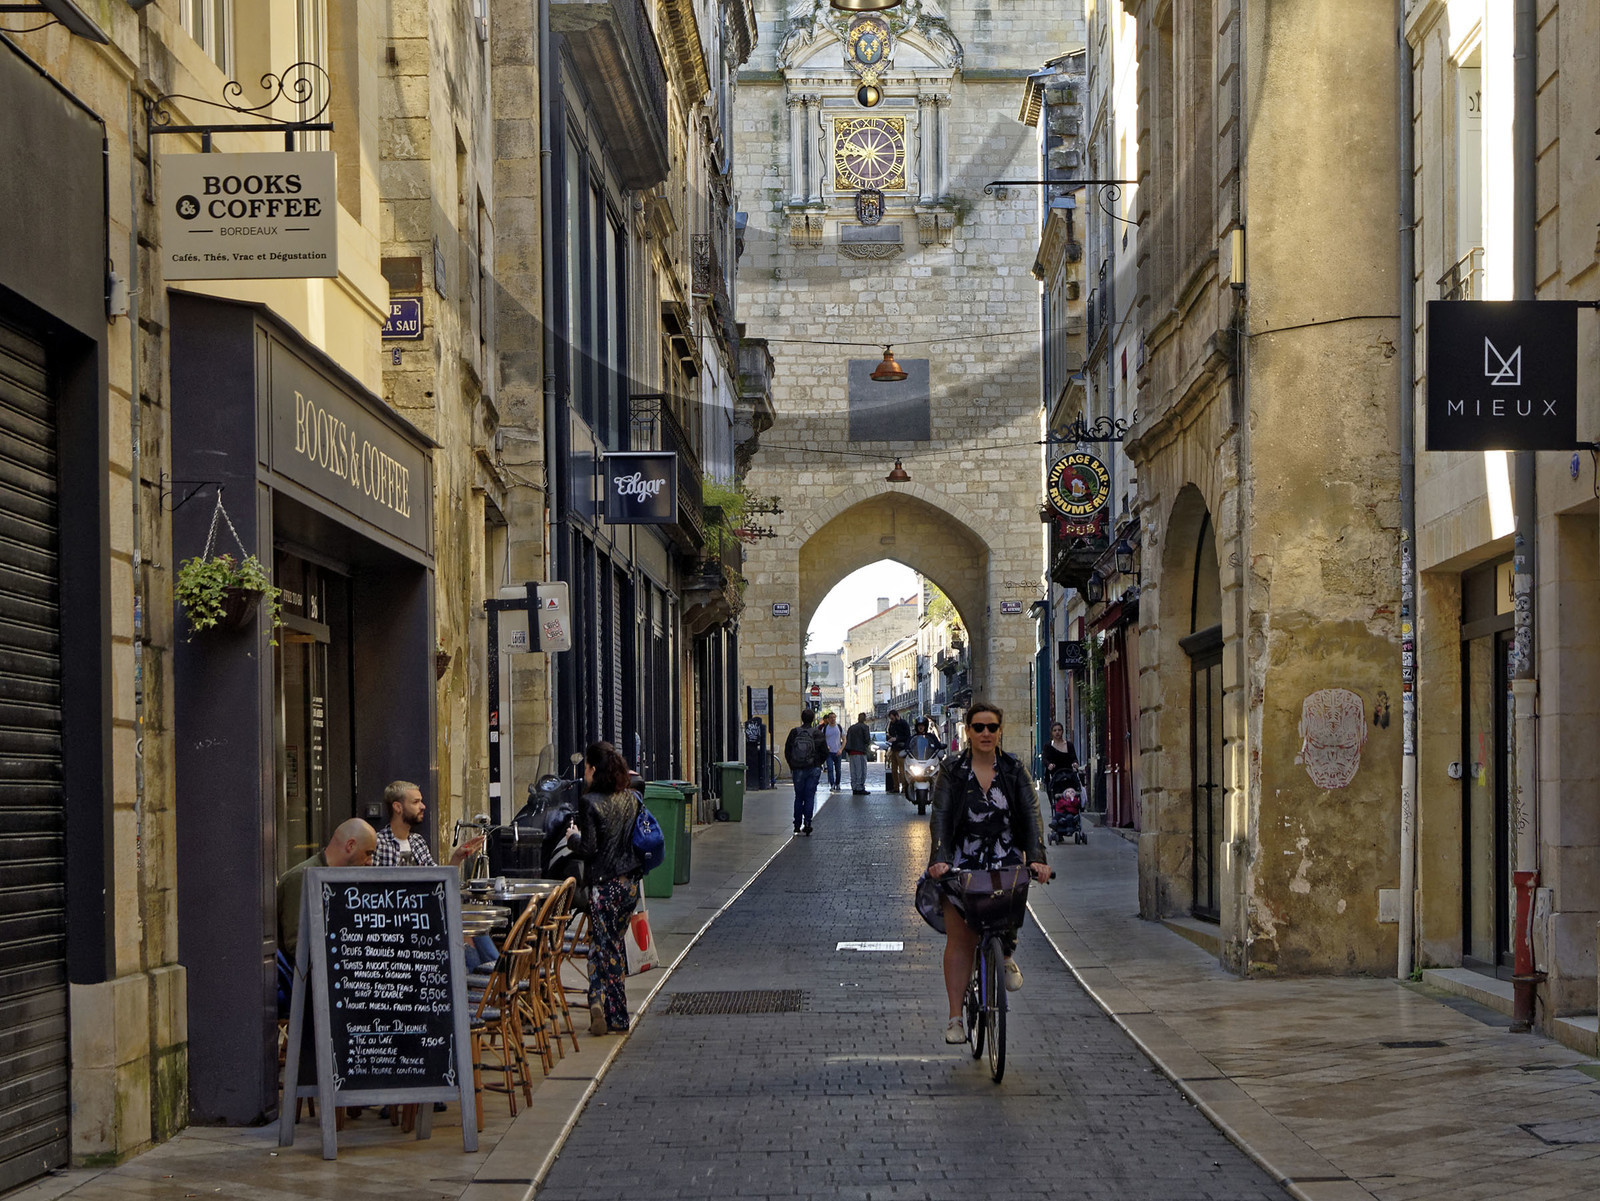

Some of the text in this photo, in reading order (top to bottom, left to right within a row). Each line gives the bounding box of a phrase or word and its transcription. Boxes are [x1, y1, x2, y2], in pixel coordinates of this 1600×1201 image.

[203, 174, 302, 195] BOOKS
[208, 198, 322, 219] COFFEE
[220, 227, 278, 236] BORDEAUX
[233, 253, 254, 261] Vrac
[257, 253, 266, 261] et
[270, 251, 327, 262] Dégustation
[396, 320, 417, 331] SAU
[1448, 400, 1557, 416] MIEUX
[294, 390, 411, 519] BOOKS & COFFEE
[1050, 454, 1109, 482] VINTAGE BAR
[614, 472, 666, 503] Edgar
[1049, 486, 1109, 514] RHUMERIE
[1066, 524, 1095, 535] PUB
[339, 927, 363, 941] BACON
[366, 933, 380, 942] AND
[380, 933, 404, 943] TOASTS
[397, 949, 410, 958] AND
[412, 950, 435, 960] TOASTS
[341, 959, 363, 970] TOASTS
